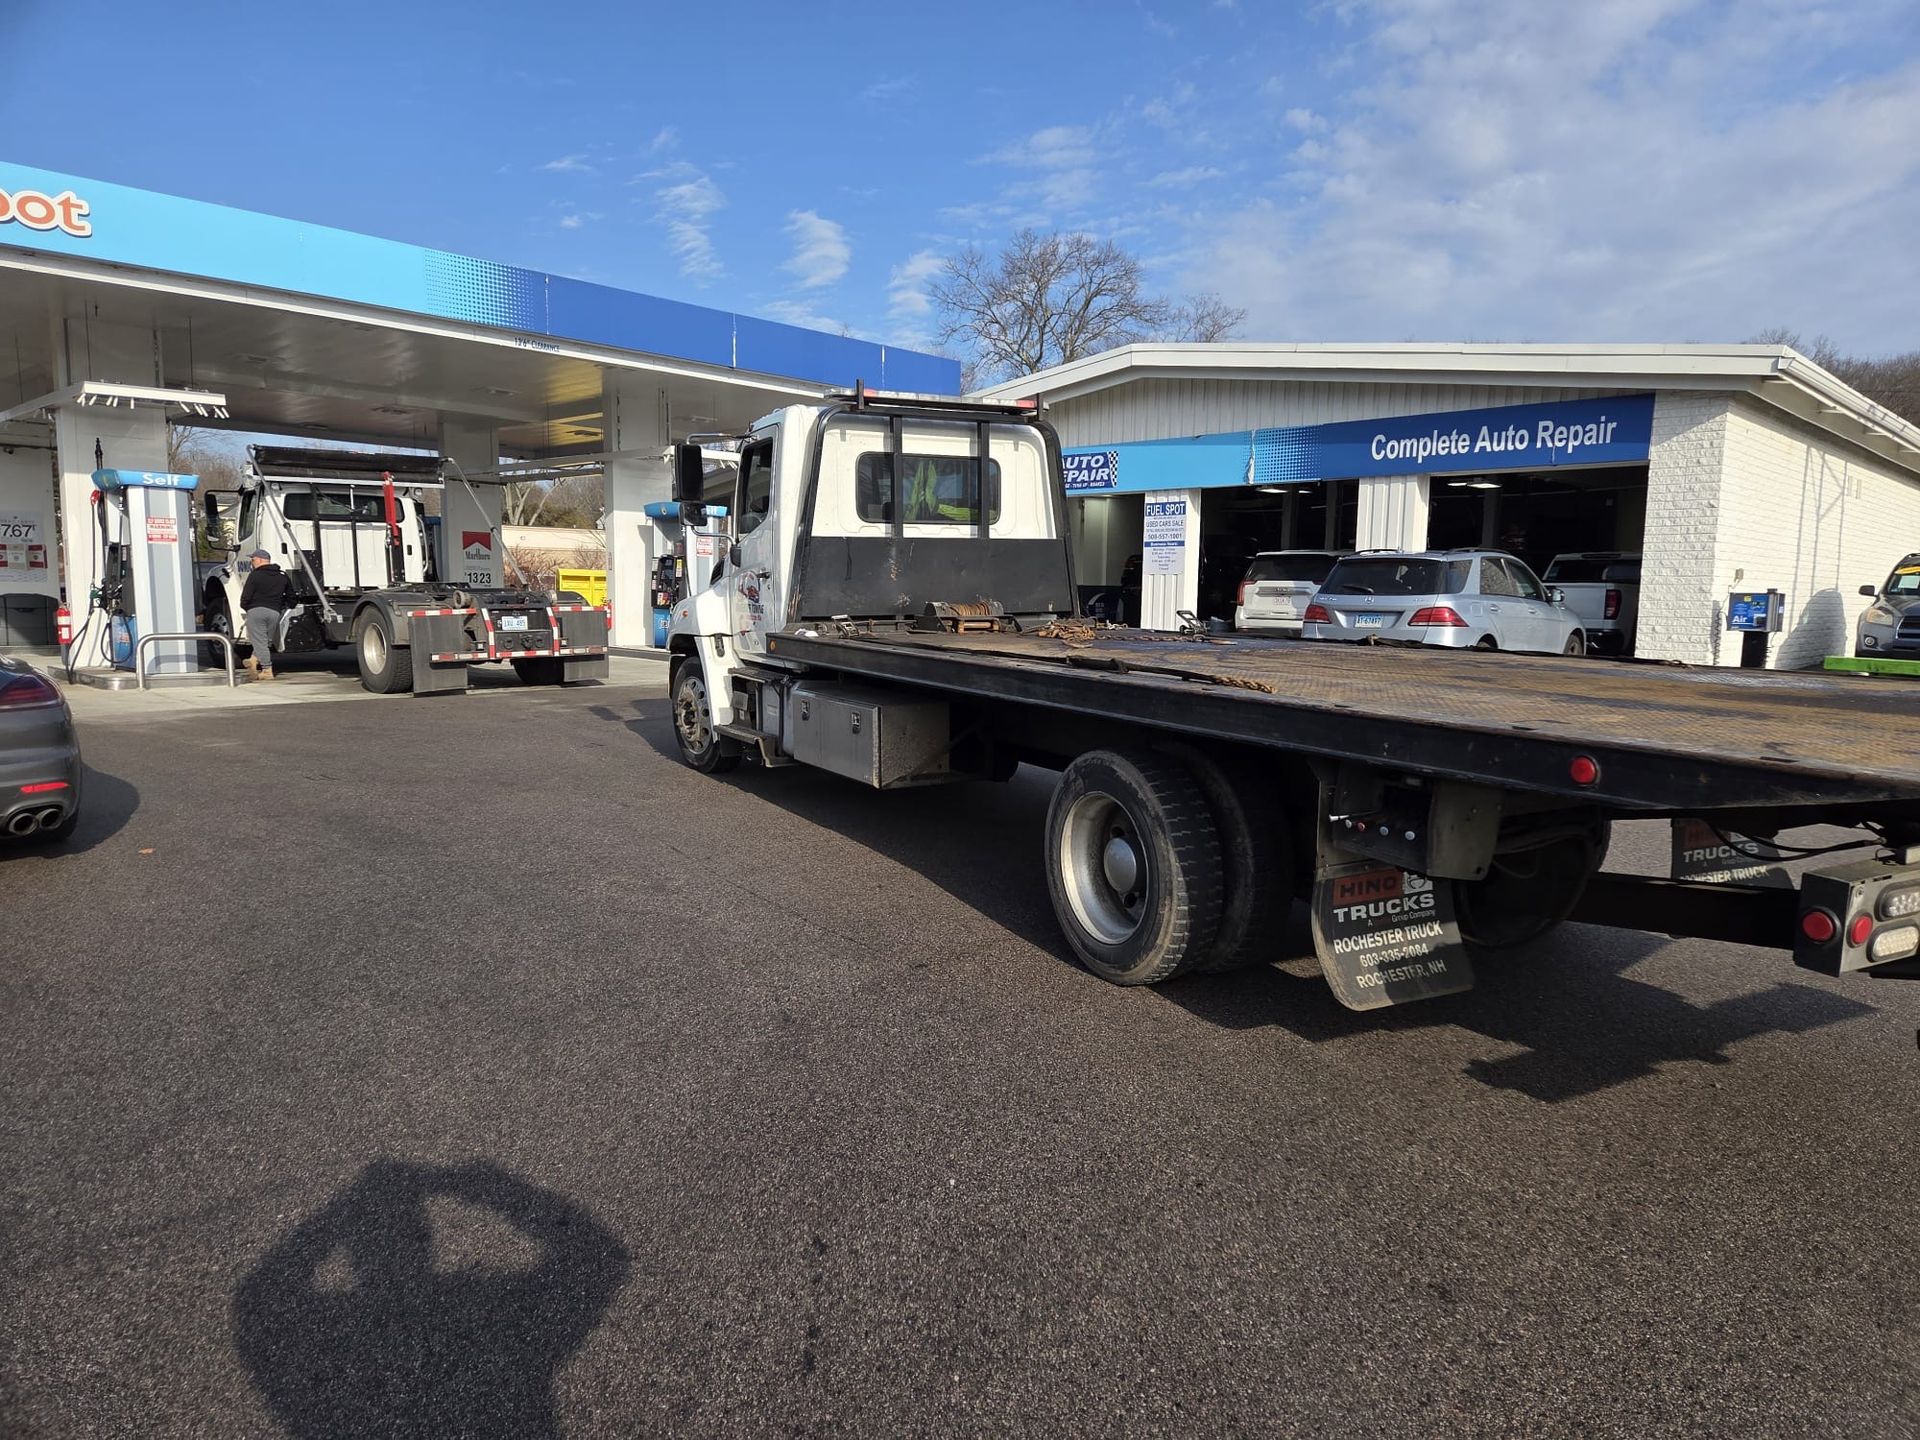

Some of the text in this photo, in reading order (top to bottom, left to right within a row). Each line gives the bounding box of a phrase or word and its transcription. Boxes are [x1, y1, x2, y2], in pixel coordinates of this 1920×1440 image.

[1371, 416, 1617, 463] Complete Auto Repair
[142, 474, 181, 486] Self
[1146, 503, 1185, 516] FUEL SPOT
[1731, 615, 1748, 623] Air
[1680, 865, 1770, 883] CHESTER TRUCK
[1340, 876, 1397, 898] HINO
[1333, 893, 1435, 923] TRUCKS
[1391, 914, 1408, 923] Group
[1409, 909, 1436, 920] Company
[1333, 920, 1444, 954] ROCHESTER TRUCK
[1360, 943, 1429, 968] 603-335-2084
[1429, 959, 1447, 975] NH
